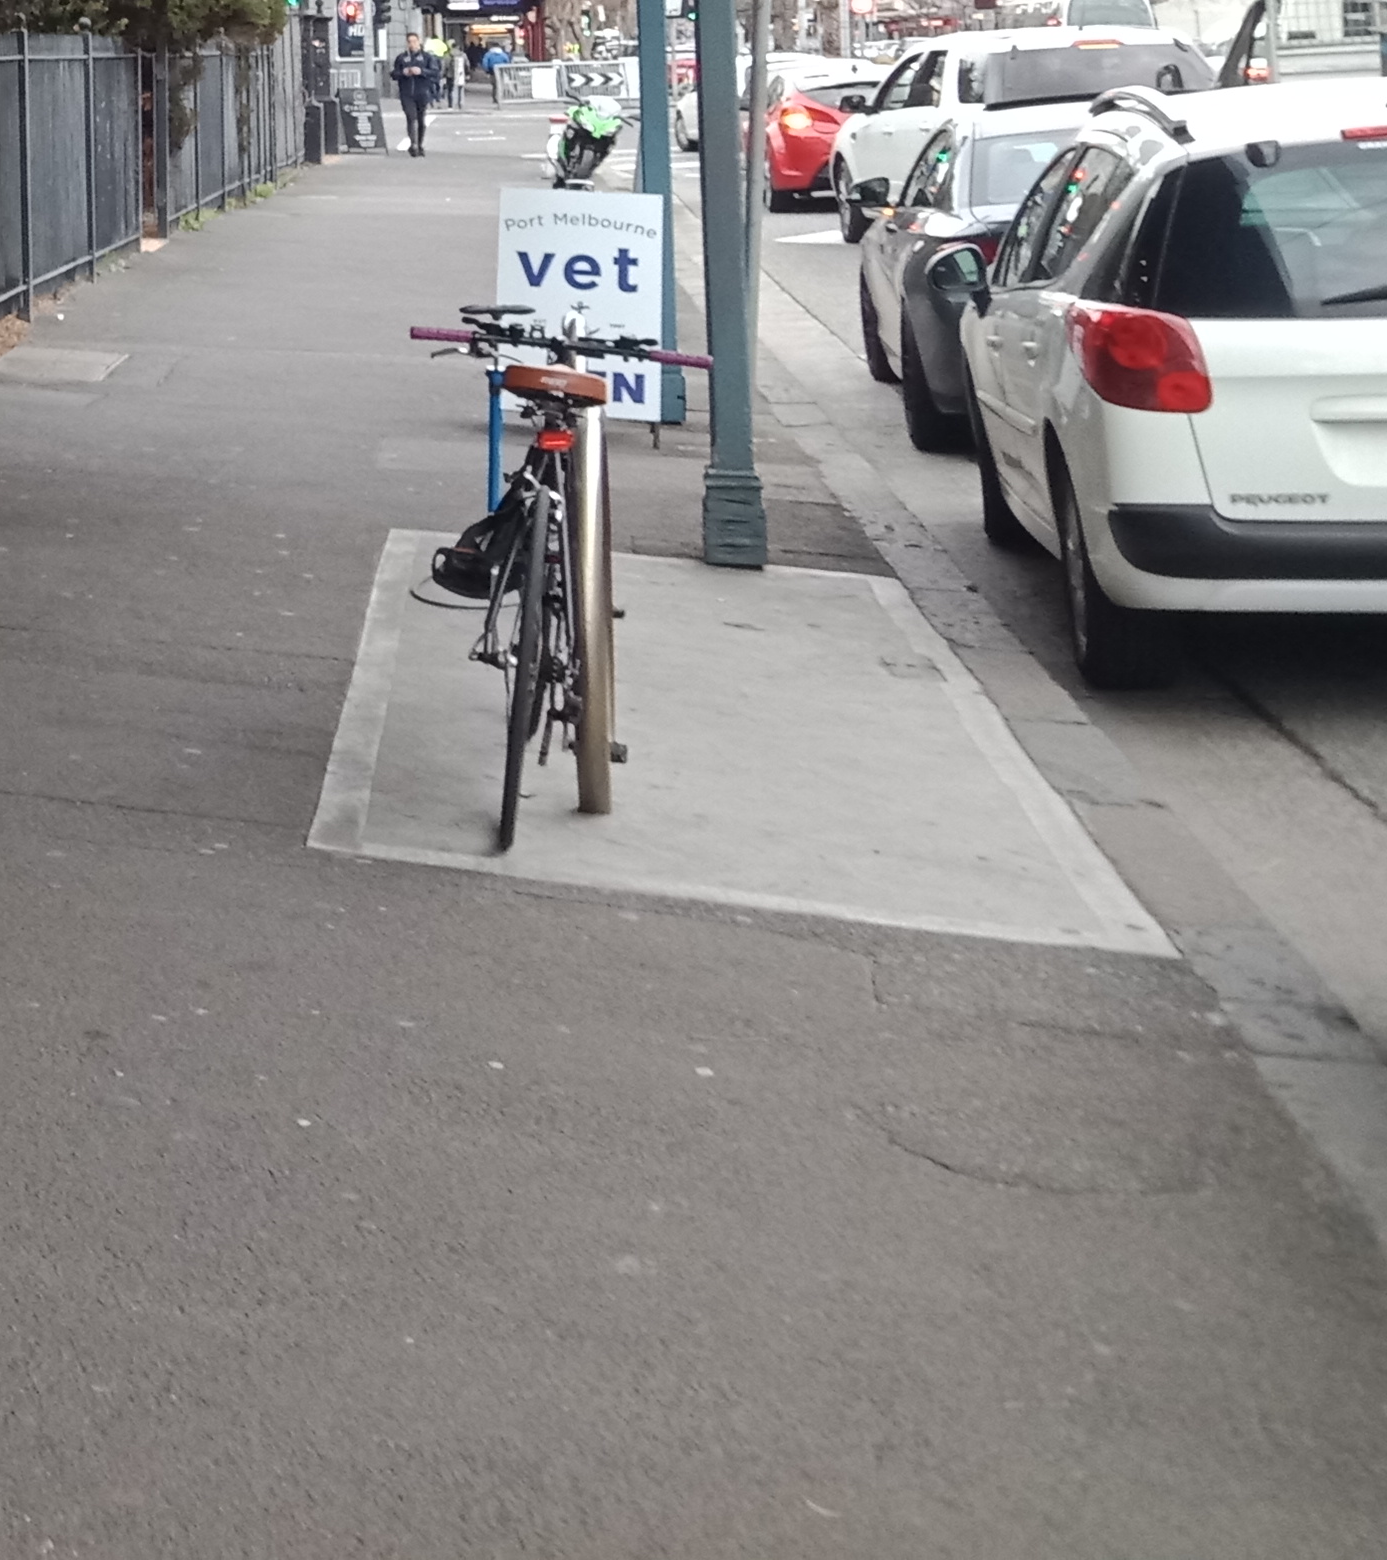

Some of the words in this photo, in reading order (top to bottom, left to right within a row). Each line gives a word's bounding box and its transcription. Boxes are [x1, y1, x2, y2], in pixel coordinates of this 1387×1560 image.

[504, 214, 544, 231] Port
[553, 212, 658, 239] Melbourne
[516, 247, 640, 293] vet
[1230, 492, 1329, 507] PEUGEOT
